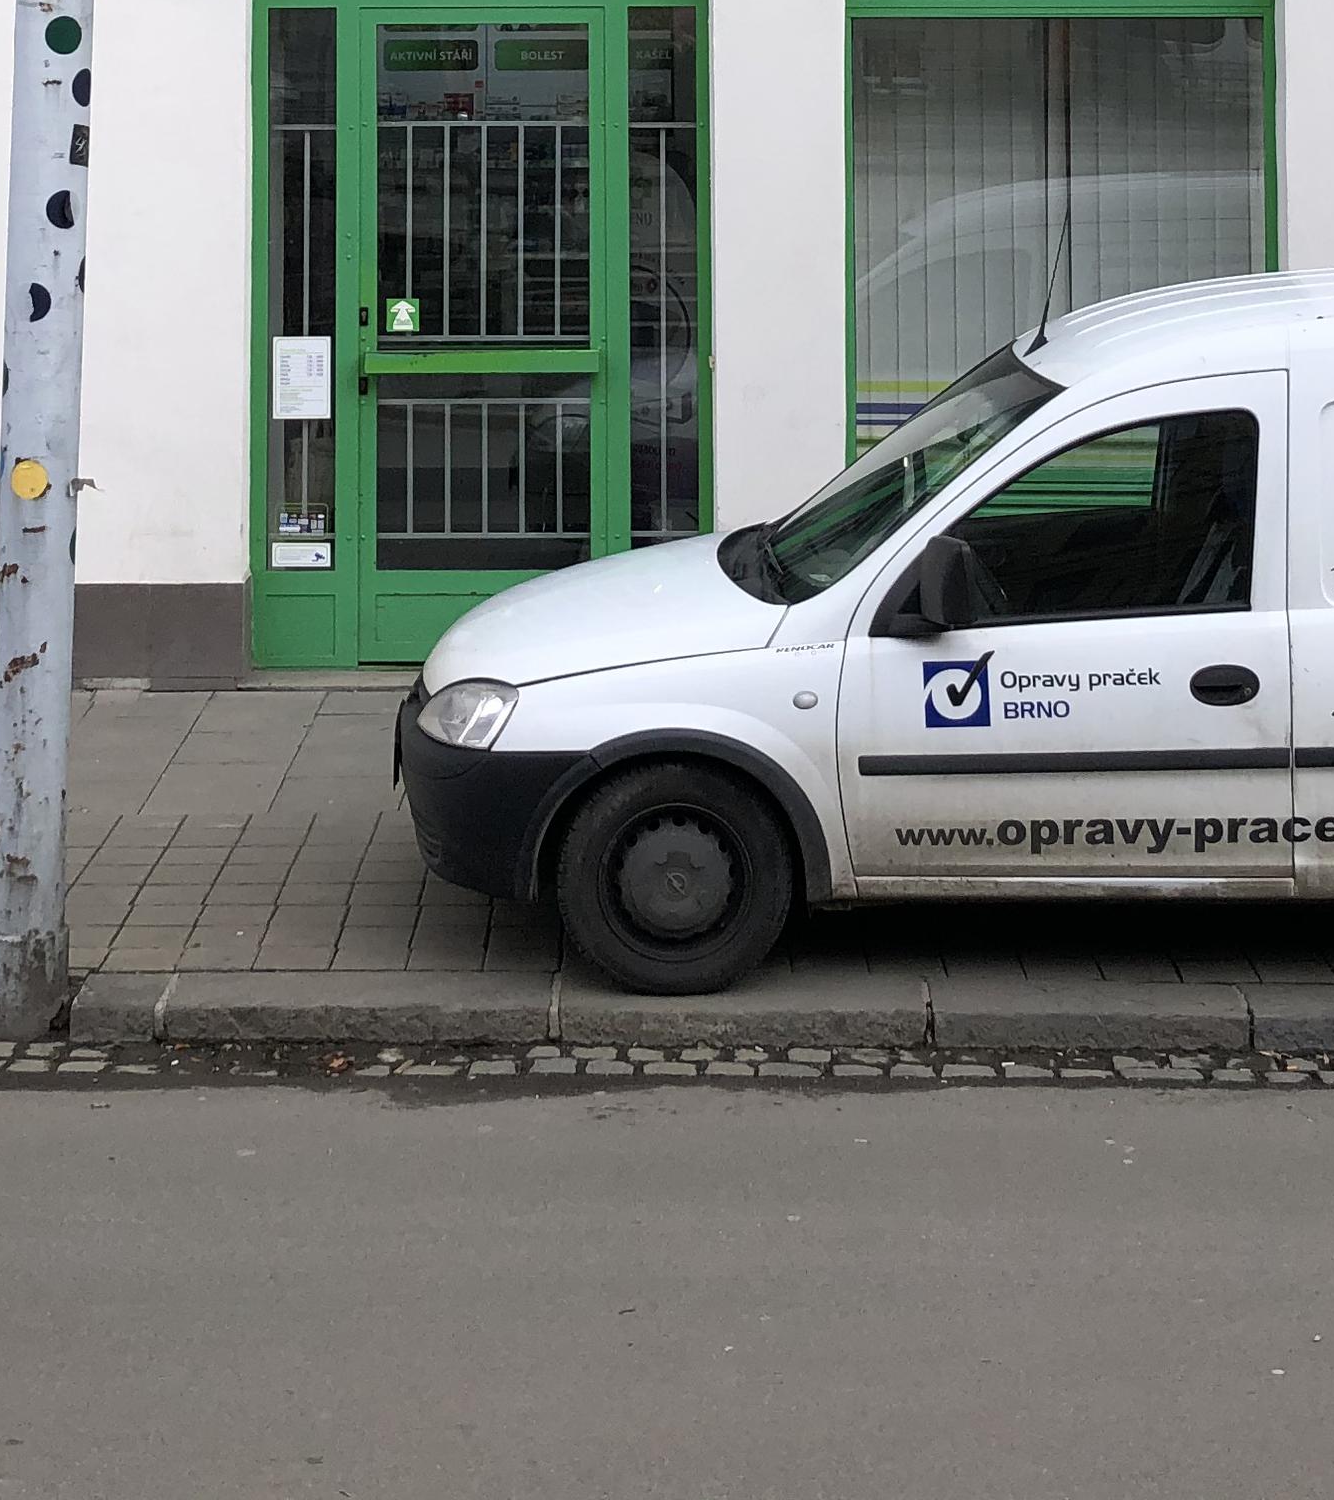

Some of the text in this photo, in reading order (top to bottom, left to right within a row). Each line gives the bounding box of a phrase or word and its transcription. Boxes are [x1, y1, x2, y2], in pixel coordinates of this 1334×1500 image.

[390, 49, 436, 61] AKTIVNÍ
[520, 50, 565, 61] BOLEST
[1000, 665, 1162, 693] Opravy praček
[1004, 701, 1071, 720] BRNO
